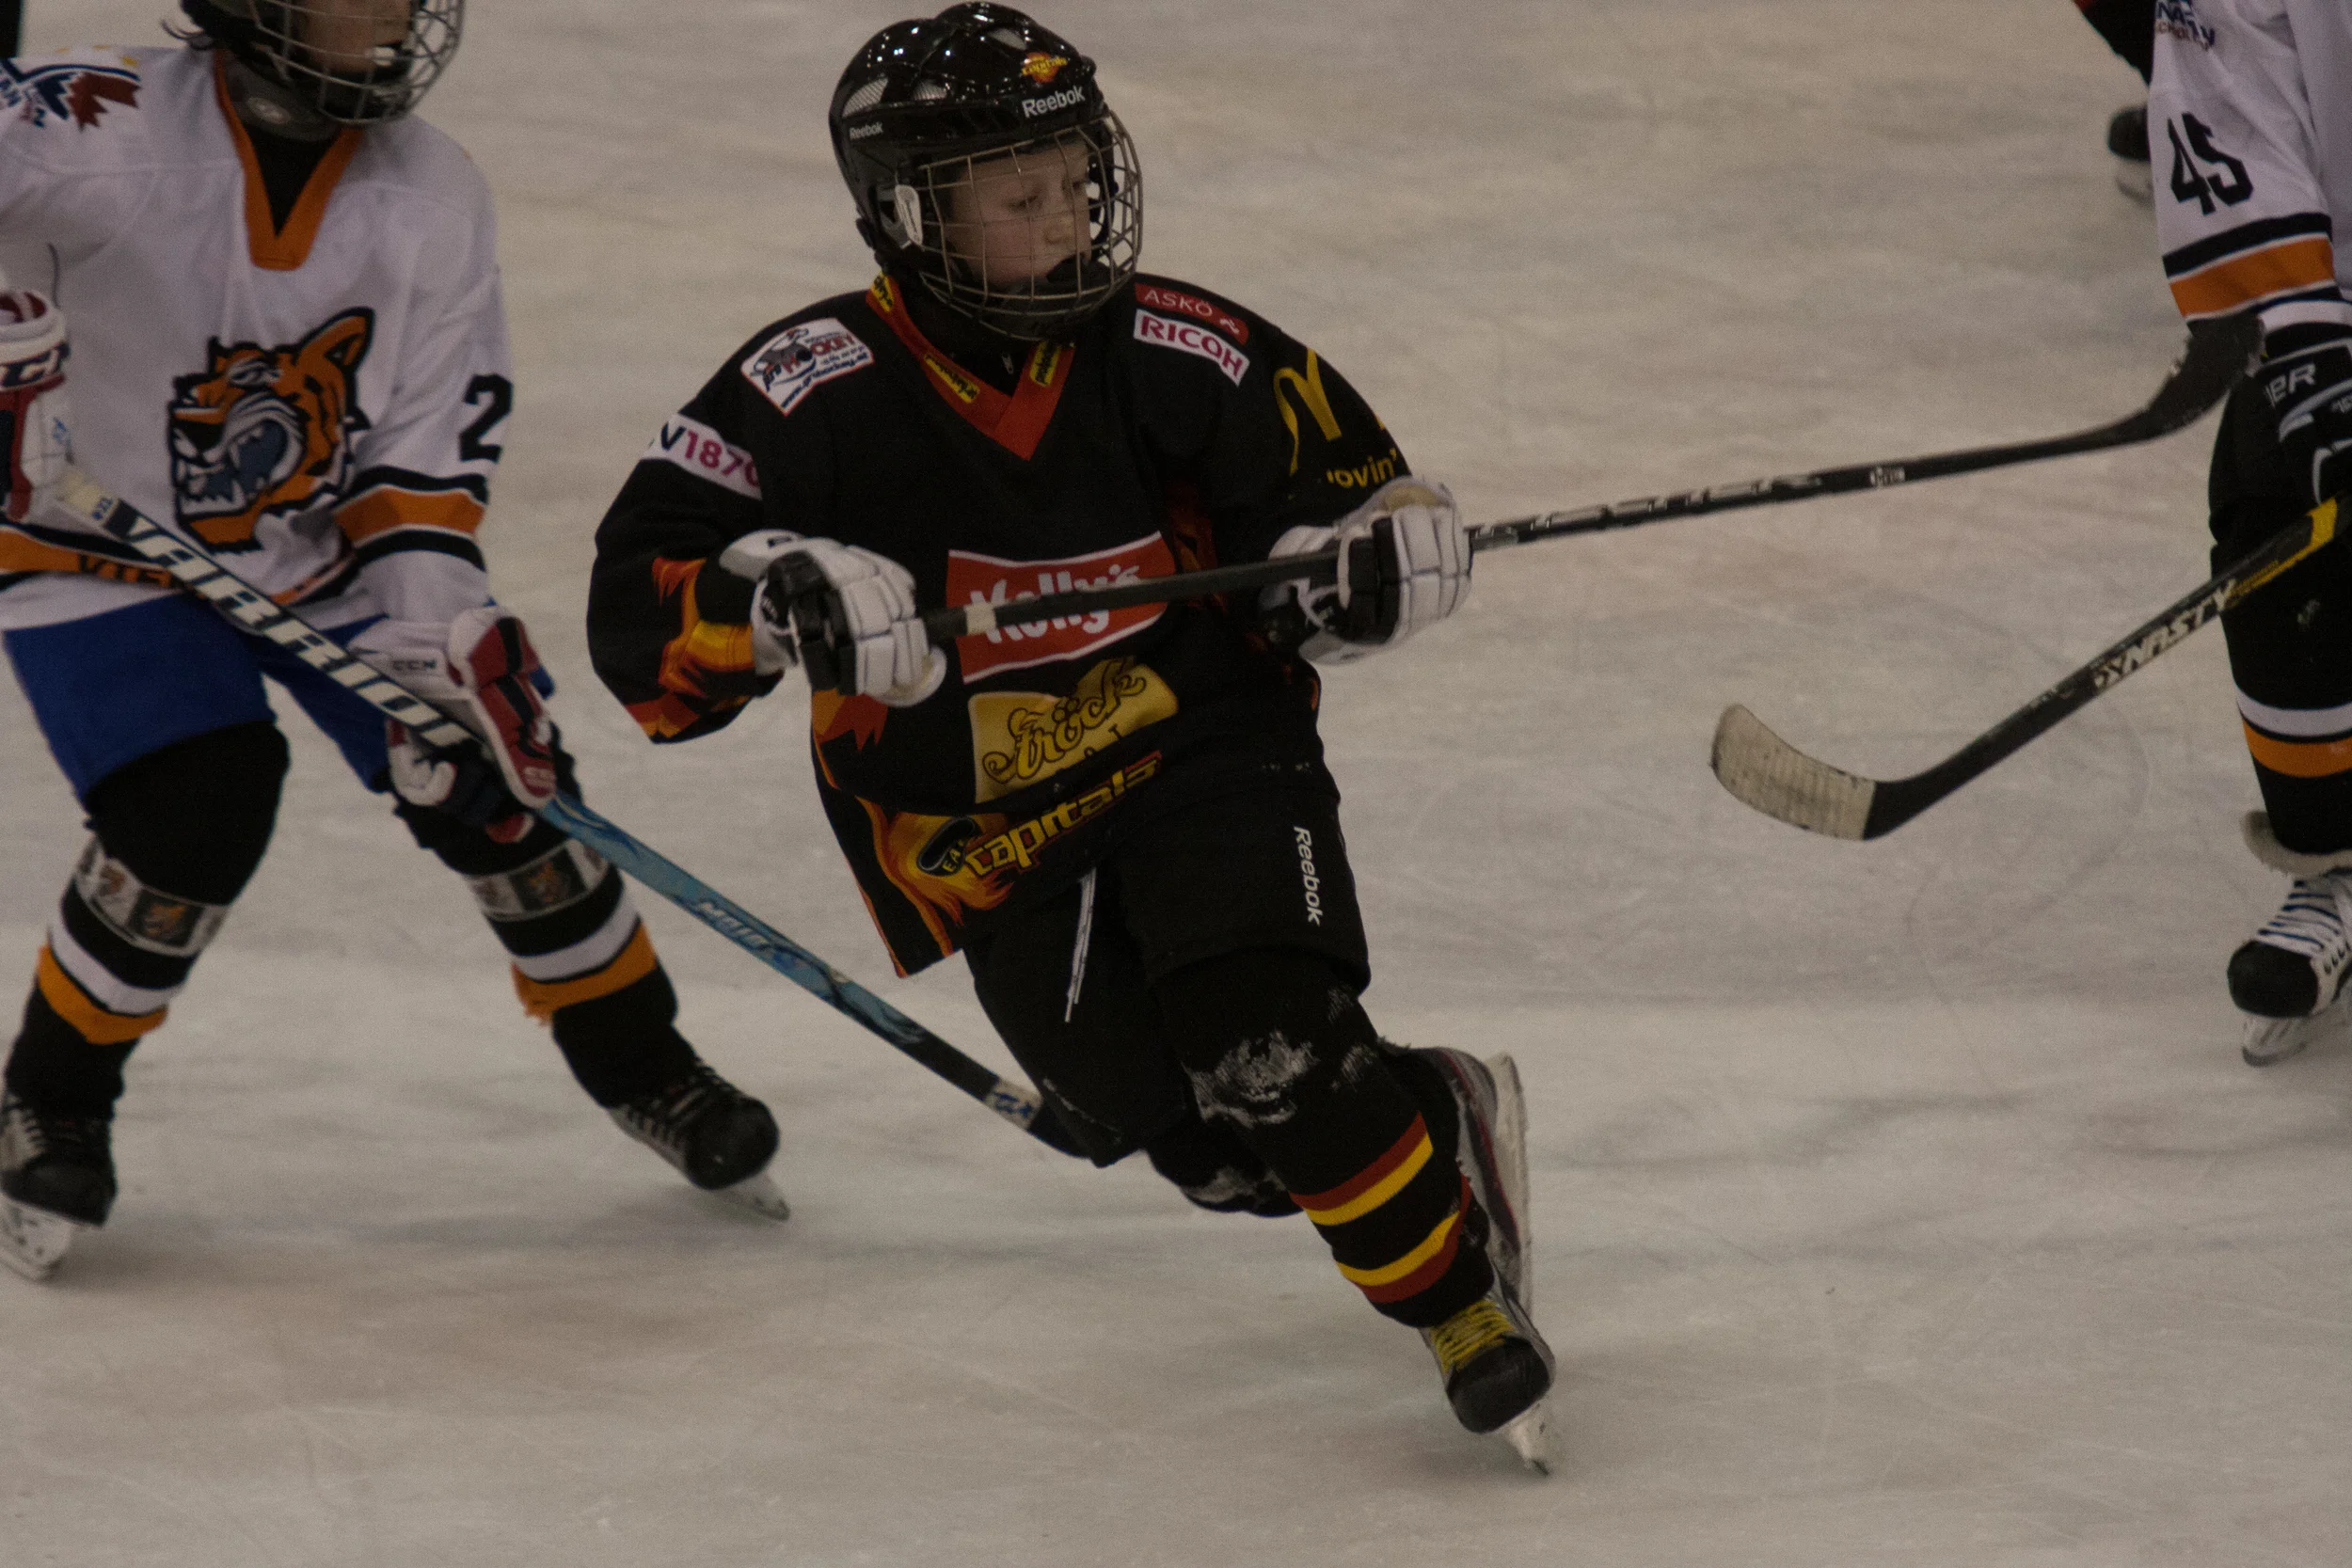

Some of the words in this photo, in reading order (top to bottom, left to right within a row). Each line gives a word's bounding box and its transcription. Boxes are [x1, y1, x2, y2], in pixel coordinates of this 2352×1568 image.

[1021, 85, 1086, 119] Reebok
[2168, 113, 2253, 215] 45
[1144, 287, 1213, 317] ASKÖ
[1140, 315, 1243, 376] RICOH
[460, 375, 513, 461] 2
[1294, 825, 1324, 927] Reebok
